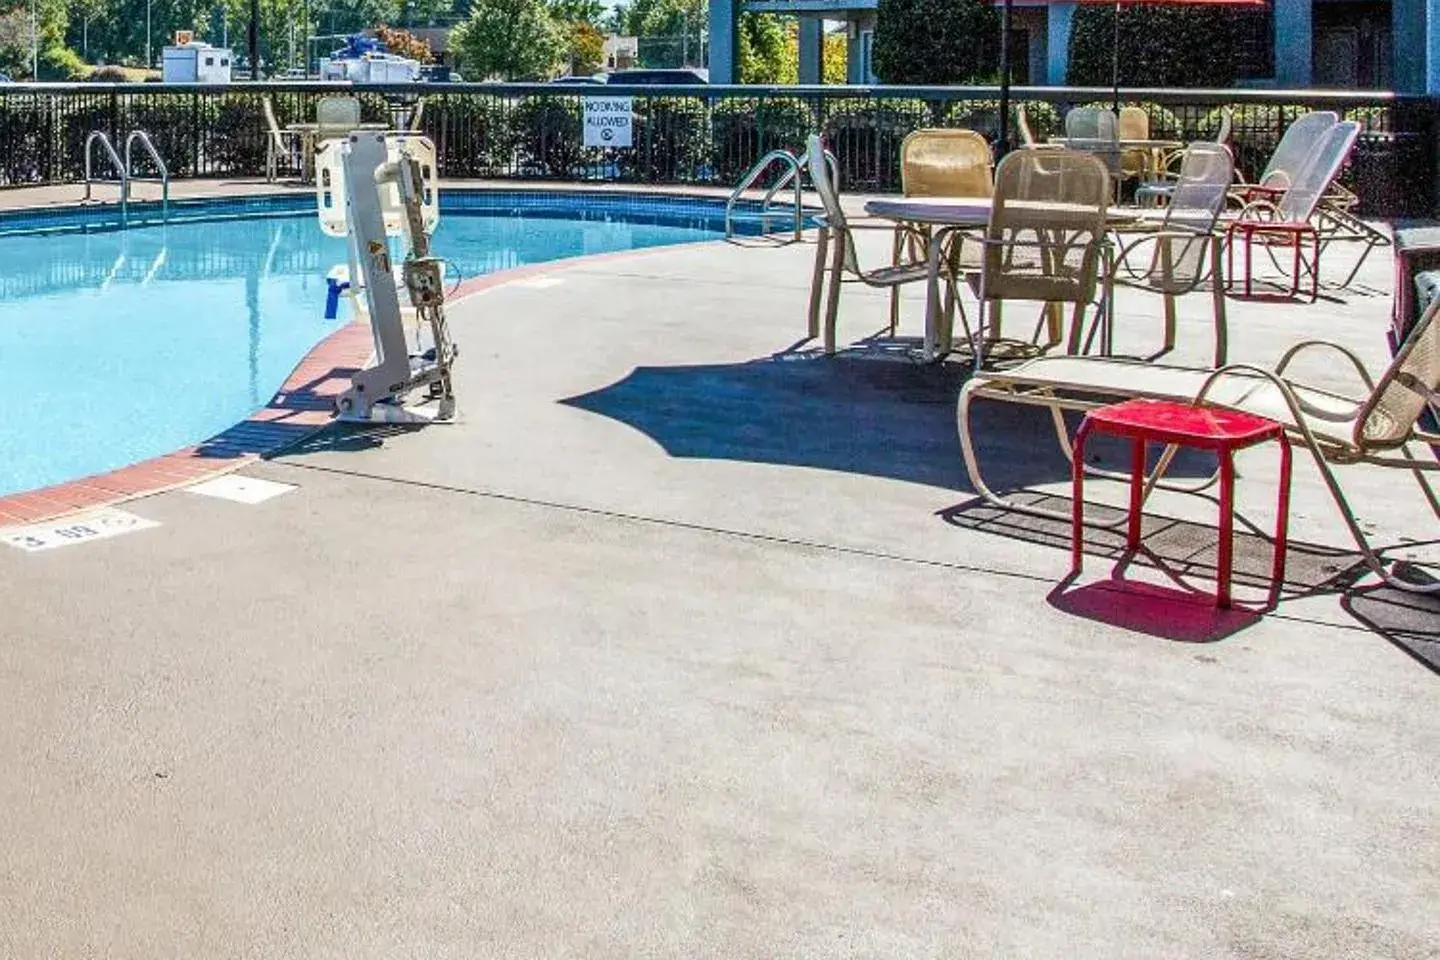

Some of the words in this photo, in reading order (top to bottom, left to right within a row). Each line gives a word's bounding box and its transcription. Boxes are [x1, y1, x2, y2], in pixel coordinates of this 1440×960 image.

[585, 101, 598, 112] NO
[600, 101, 629, 112] DIVING
[587, 116, 628, 127] ALLOWED
